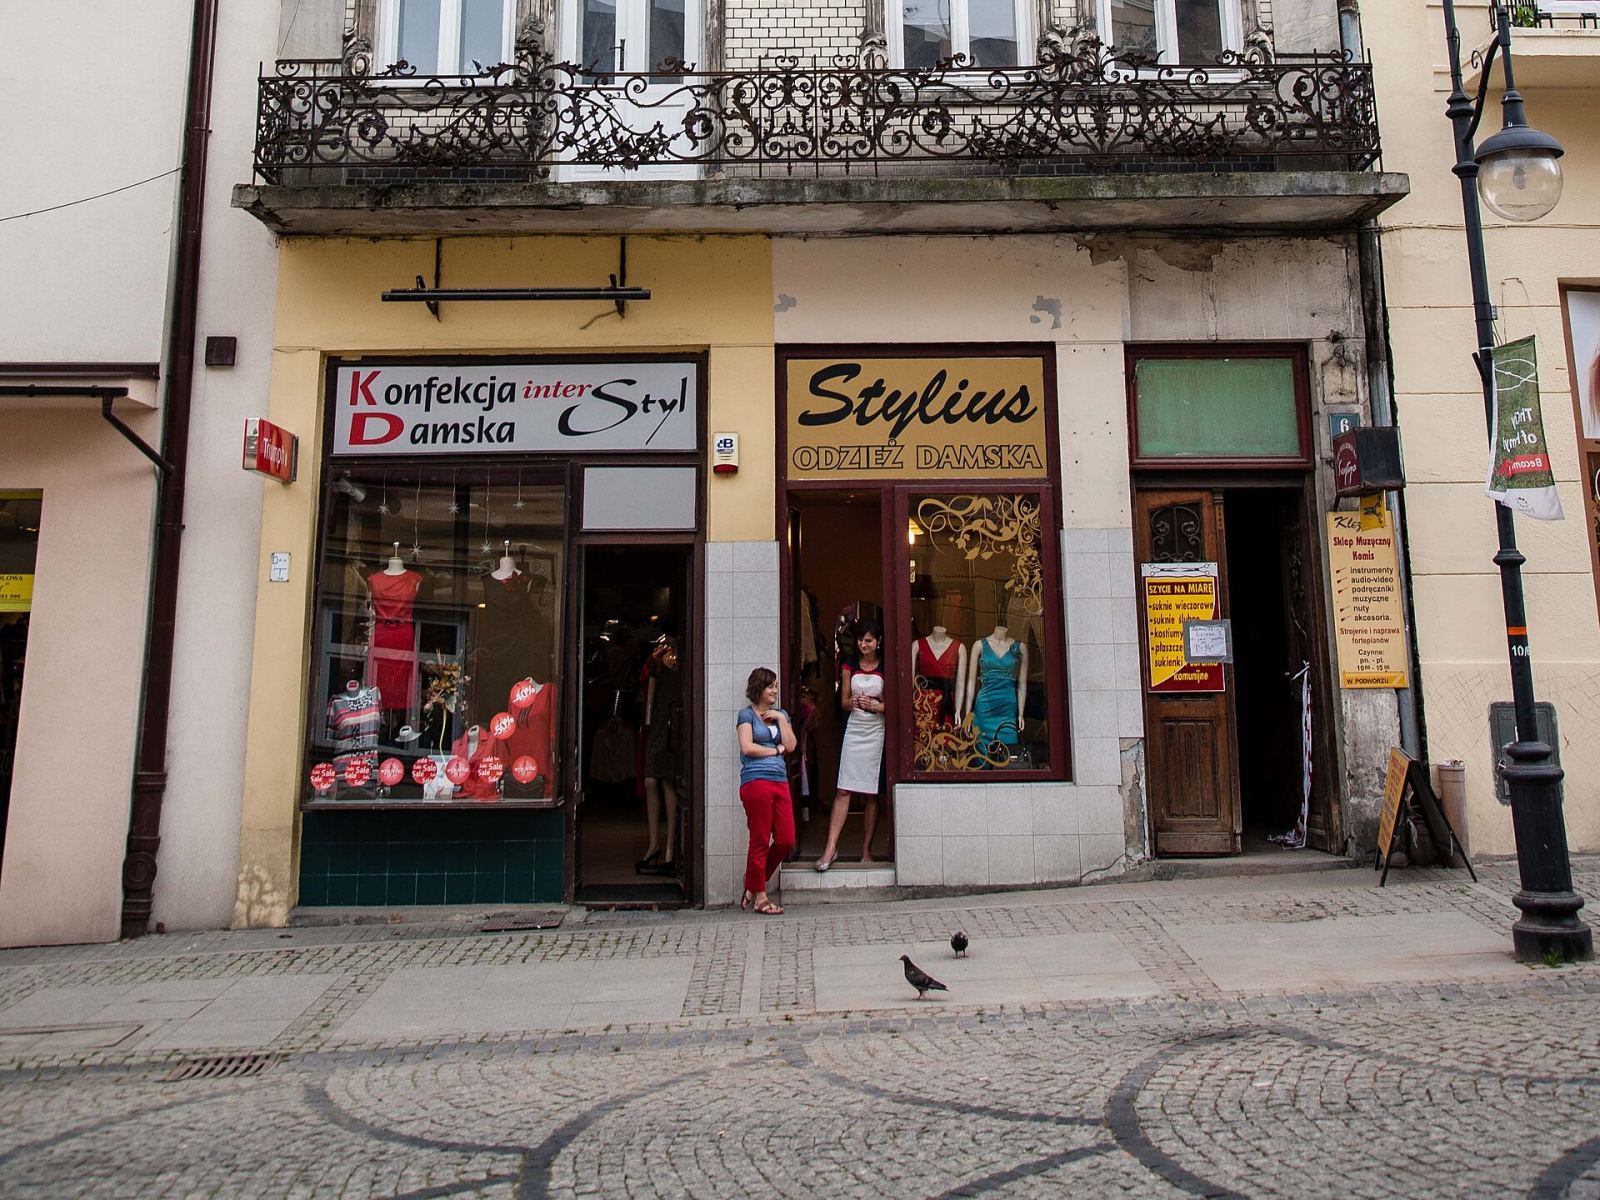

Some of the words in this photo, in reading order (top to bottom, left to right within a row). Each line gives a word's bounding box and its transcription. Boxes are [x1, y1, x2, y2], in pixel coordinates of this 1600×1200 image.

[350, 370, 516, 411] Konfekcja
[798, 363, 1038, 439] Stylius
[522, 380, 593, 399] inter
[558, 377, 688, 445] Styl
[348, 412, 516, 445] Damska
[793, 438, 904, 470] ODZIEŻ
[916, 445, 1043, 469] DAMSKA
[1333, 537, 1354, 548] Sklep
[1356, 536, 1391, 548] Muzyczny
[1352, 550, 1375, 561] Komis
[1351, 576, 1394, 584] audio-video
[1149, 584, 1171, 594] SZYCIE
[1174, 584, 1186, 594] NA
[1351, 585, 1394, 594] podręczniki
[1152, 600, 1172, 610] suknie
[1175, 600, 1214, 610] wieczorowe
[1352, 596, 1389, 604] muzyczne
[1353, 605, 1370, 613] nuty
[1153, 613, 1175, 624] suknie
[1154, 627, 1184, 641] kostiumy
[1340, 627, 1368, 636] Strojenie
[1373, 628, 1400, 636] naprawa
[1352, 637, 1390, 645] fortepianów
[356, 765, 370, 774] Sale
[422, 763, 437, 772] Sale
[488, 762, 503, 771] Sale
[412, 770, 424, 778] Sale
